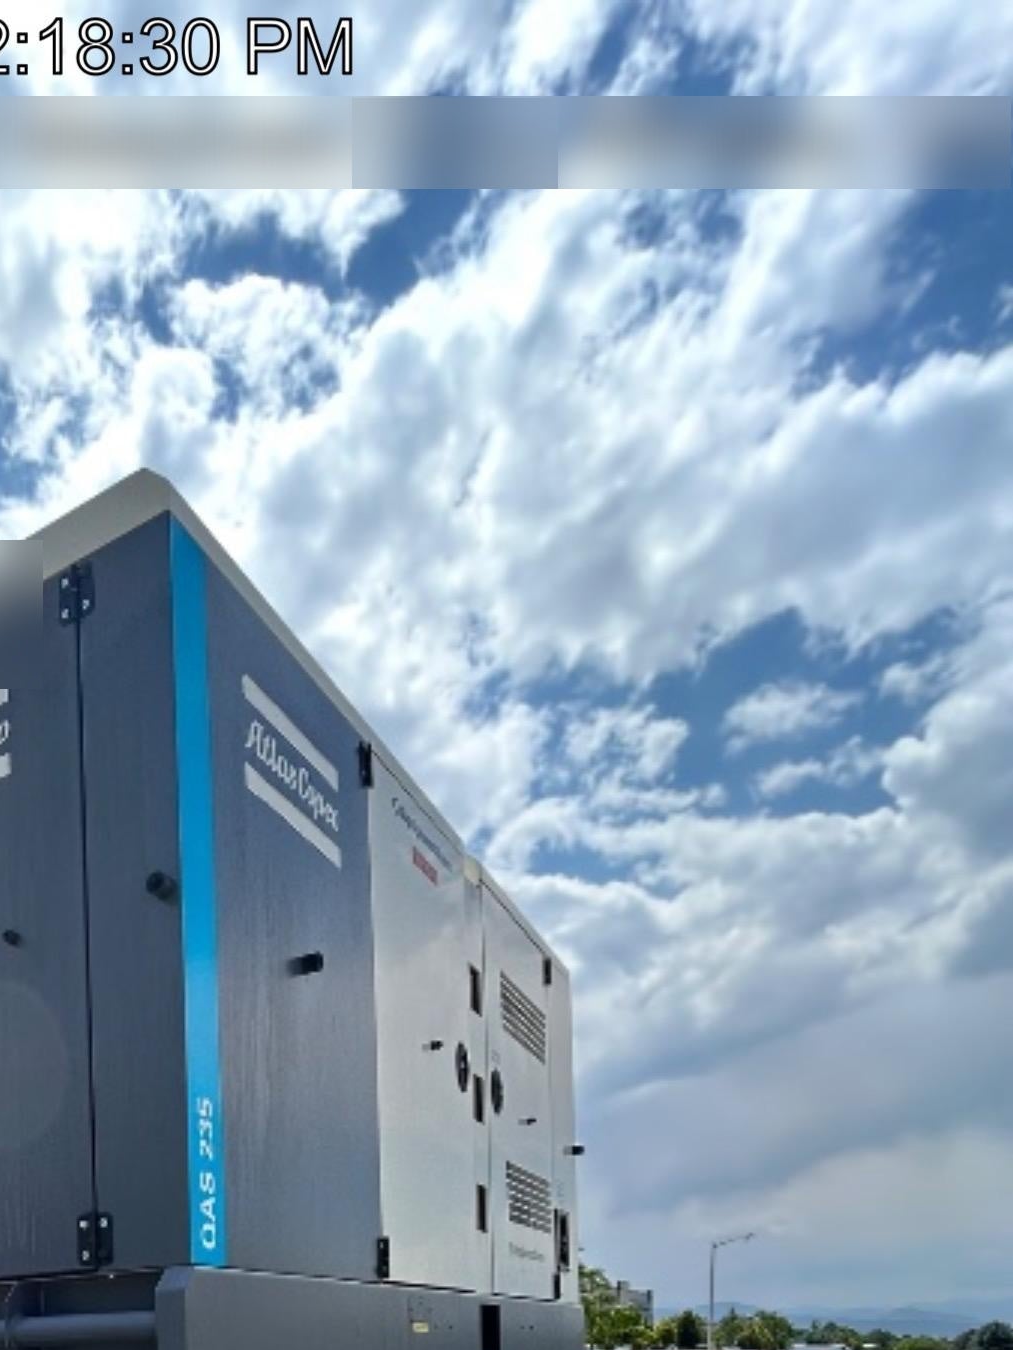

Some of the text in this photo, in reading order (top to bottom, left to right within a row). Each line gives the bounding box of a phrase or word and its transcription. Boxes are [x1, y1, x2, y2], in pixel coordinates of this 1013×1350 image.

[245, 719, 297, 790] Atlas
[198, 1097, 217, 1250] QAS 235
